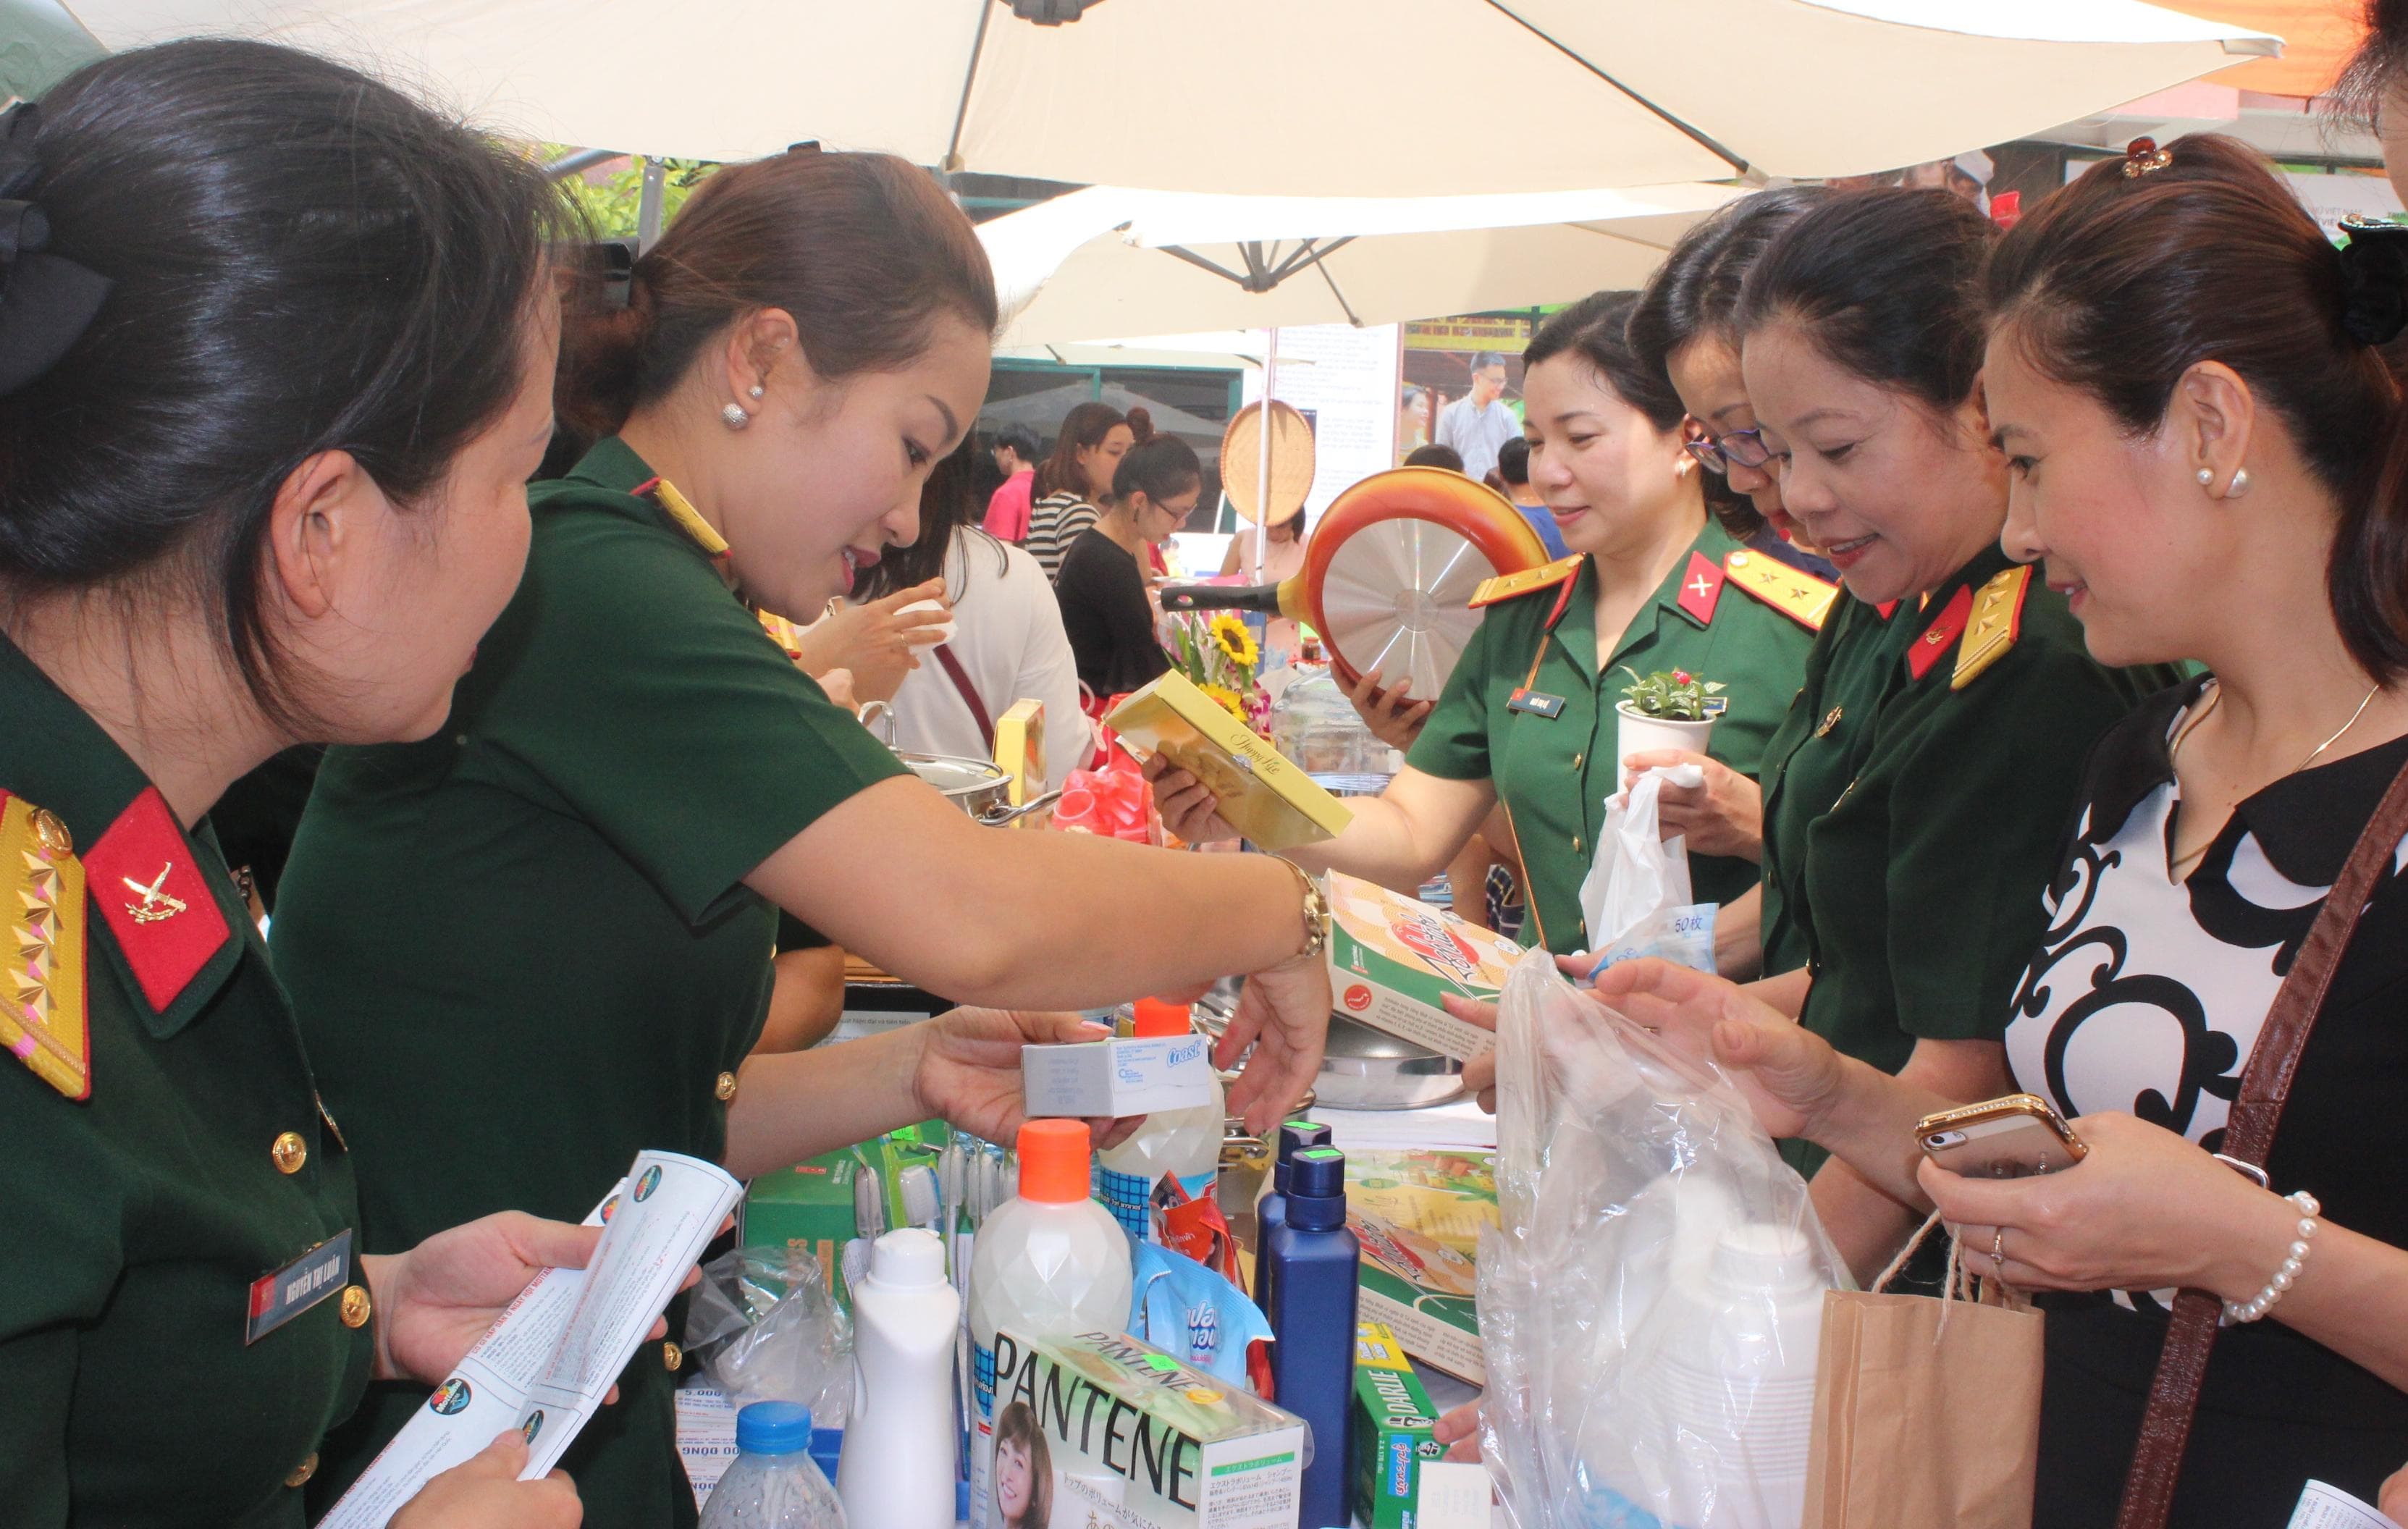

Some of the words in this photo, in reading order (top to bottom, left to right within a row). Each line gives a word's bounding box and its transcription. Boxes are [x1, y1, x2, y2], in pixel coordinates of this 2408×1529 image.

[1167, 1040, 1202, 1067] Coast
[1368, 1370, 1420, 1414] DARLIE
[993, 1331, 1202, 1512] PANTENE
